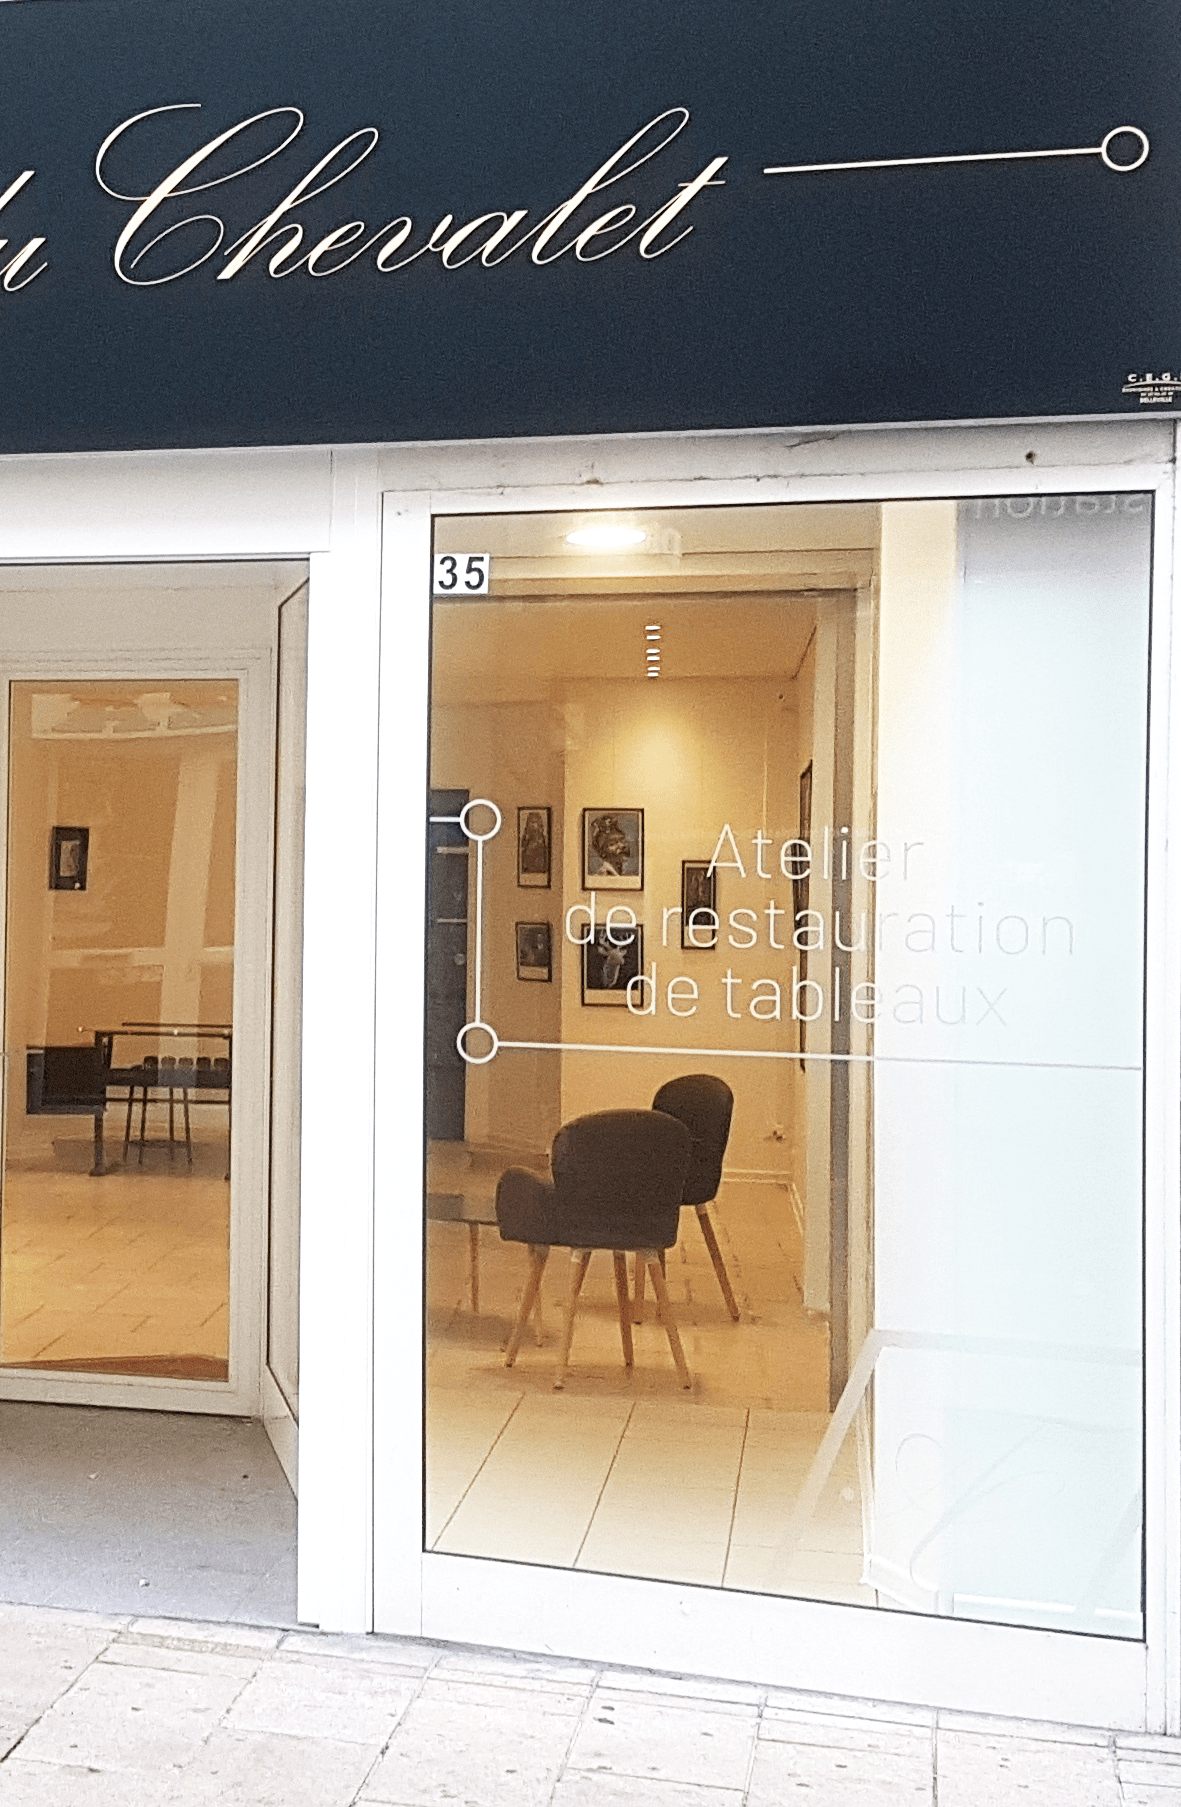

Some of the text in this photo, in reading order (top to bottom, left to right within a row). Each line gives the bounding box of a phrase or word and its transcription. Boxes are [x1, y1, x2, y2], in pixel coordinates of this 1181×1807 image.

[95, 103, 729, 286] Chevalet
[437, 555, 486, 591] 35
[706, 822, 925, 882] Atelier
[564, 891, 1077, 957] de restauration
[625, 961, 1009, 1028] de tableaux
